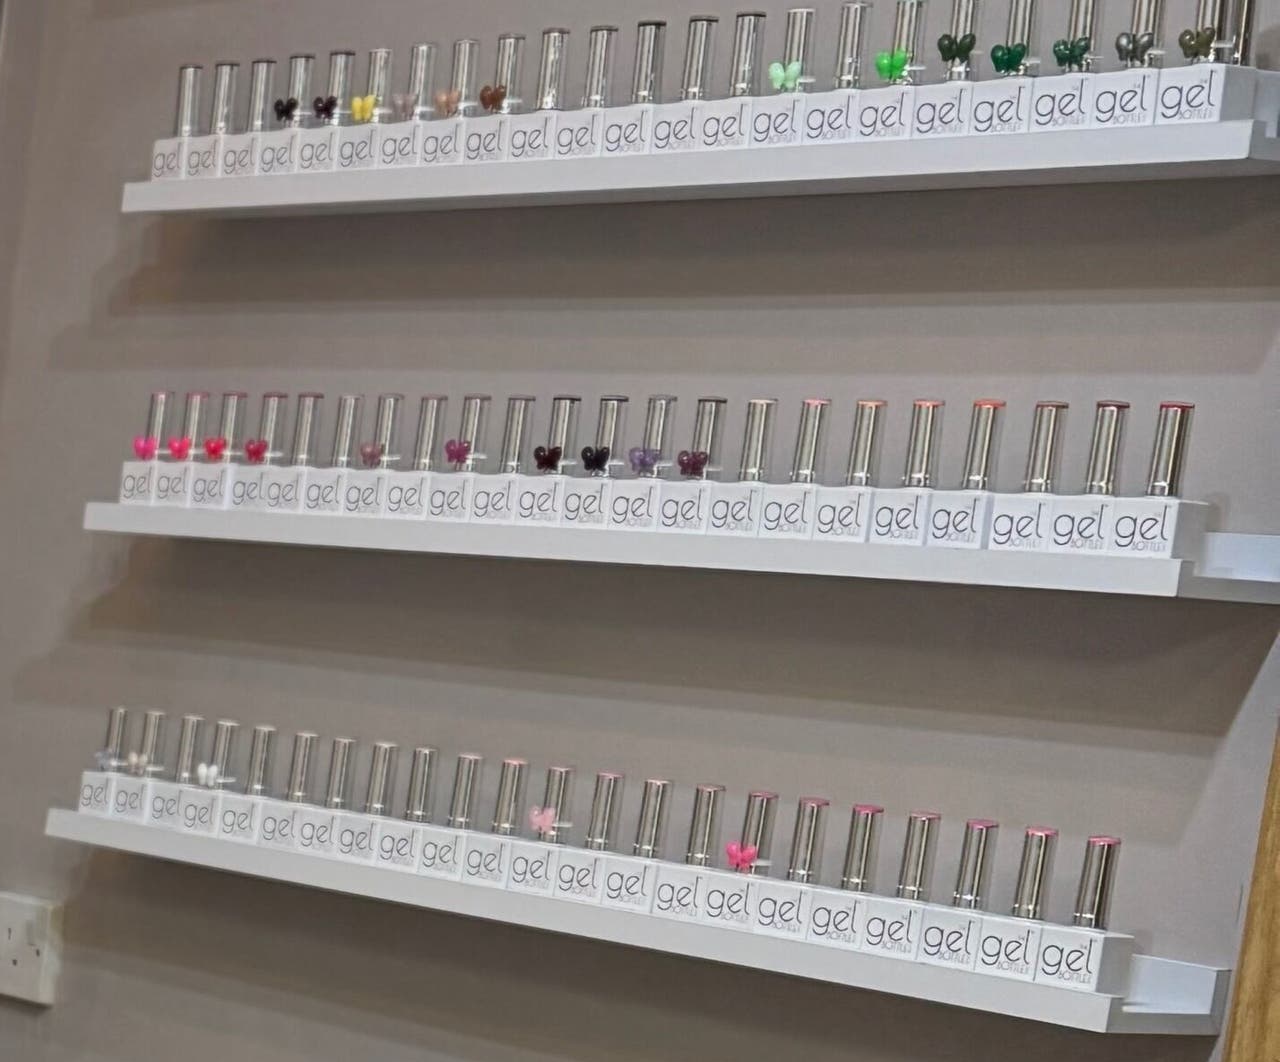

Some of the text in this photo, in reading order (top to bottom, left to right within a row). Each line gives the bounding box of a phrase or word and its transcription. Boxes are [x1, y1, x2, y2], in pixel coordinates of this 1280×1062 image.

[916, 88, 964, 133] gel
[974, 86, 1022, 132] gel
[1035, 78, 1085, 125] gel
[1096, 75, 1147, 122] gel
[1161, 70, 1215, 118] gel
[605, 110, 645, 151] gel
[654, 107, 695, 148] gel
[703, 103, 744, 145] gel
[753, 100, 796, 142] gel
[806, 95, 851, 139] gel
[860, 92, 905, 136] gel
[261, 132, 295, 172] gel
[300, 132, 334, 168] gel
[340, 129, 373, 167] gel
[382, 125, 416, 164] gel
[423, 122, 457, 162] gel
[466, 120, 502, 159] gel
[511, 117, 548, 157] gel
[557, 114, 595, 155] gel
[153, 142, 181, 177] gel
[187, 139, 216, 175] gel
[224, 135, 255, 173] gel
[123, 466, 152, 498] gel
[158, 466, 187, 499] gel
[193, 470, 225, 502] gel
[233, 472, 263, 505] gel
[267, 472, 300, 506] gel
[307, 475, 340, 508] gel
[346, 477, 381, 511] gel
[389, 477, 423, 511] gel
[430, 479, 466, 516] gel
[474, 481, 511, 517] gel
[519, 482, 557, 518] gel
[565, 484, 603, 520] gel
[612, 487, 652, 523] gel
[661, 488, 702, 526] gel
[711, 489, 753, 528] gel
[764, 491, 807, 530] gel
[818, 493, 861, 533] gel
[875, 495, 918, 536] gel
[932, 498, 976, 539] gel
[993, 503, 1043, 544] gel
[1053, 504, 1103, 545] gel
[1115, 505, 1167, 547] gel
[81, 778, 108, 807] gel
[115, 784, 144, 813] gel
[152, 790, 182, 819] gel
[184, 796, 213, 828] gel
[222, 802, 254, 833] gel
[262, 810, 295, 840] gel
[301, 816, 334, 848] gel
[340, 822, 374, 854] gel
[380, 828, 415, 860] gel
[423, 835, 458, 867] gel
[467, 843, 504, 876] gel
[512, 850, 550, 883] gel
[559, 858, 597, 891] gel
[606, 865, 647, 899] gel
[657, 876, 699, 911] gel
[707, 882, 750, 917] gel
[758, 891, 802, 926] gel
[812, 900, 857, 936] gel
[866, 910, 912, 946] gel
[923, 920, 972, 956] gel
[981, 930, 1029, 965] gel
[1041, 939, 1092, 976] gel
